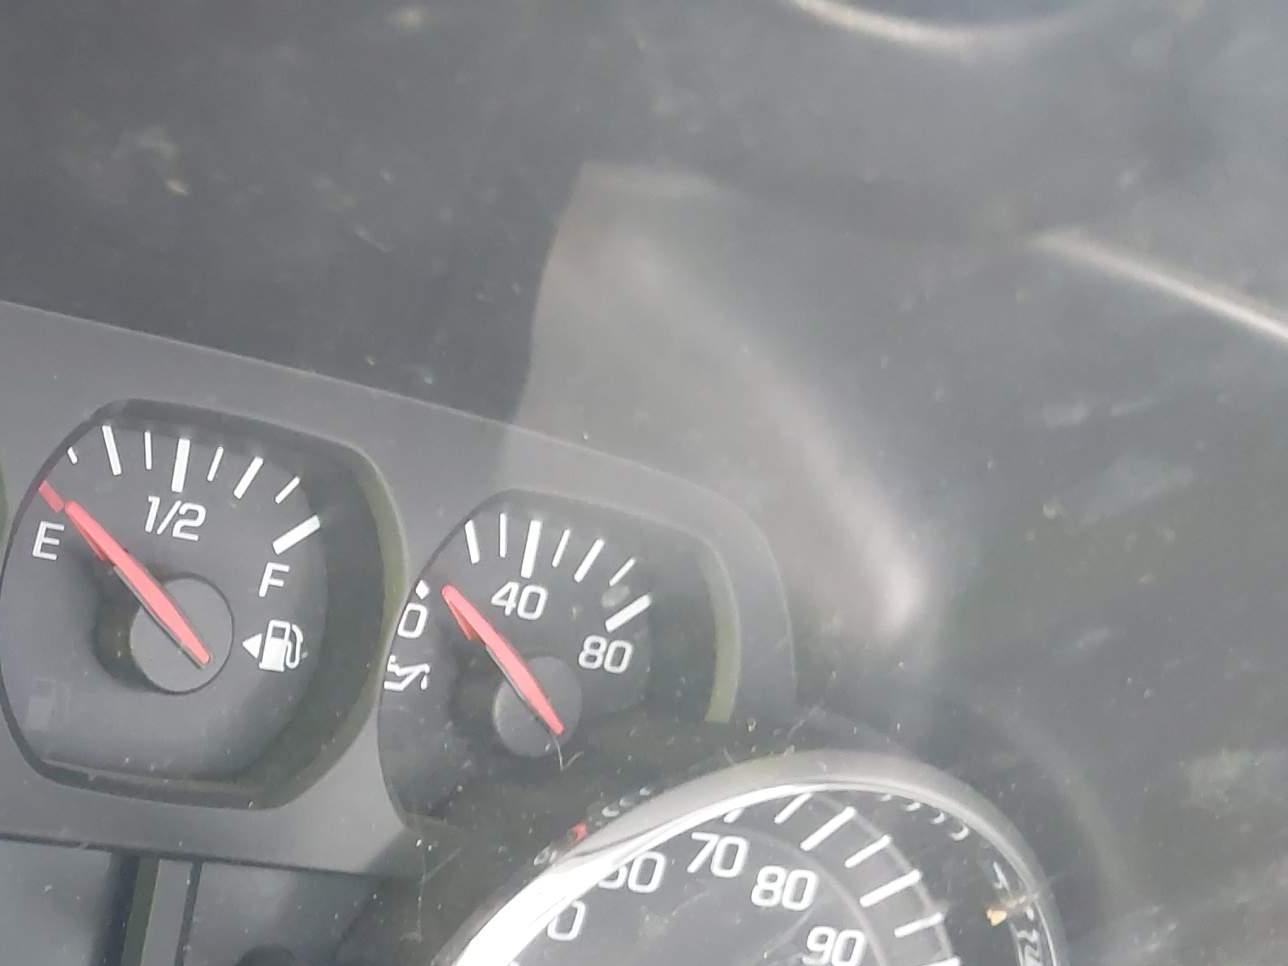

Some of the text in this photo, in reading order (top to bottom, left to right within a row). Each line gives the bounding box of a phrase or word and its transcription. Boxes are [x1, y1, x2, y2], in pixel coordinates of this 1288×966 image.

[145, 495, 208, 541] 1/2
[32, 520, 65, 561] E
[258, 561, 290, 598] F
[397, 602, 429, 639] 0
[490, 581, 549, 621] 40
[578, 635, 633, 674] 80
[689, 831, 749, 878] 70
[750, 865, 819, 912] 80
